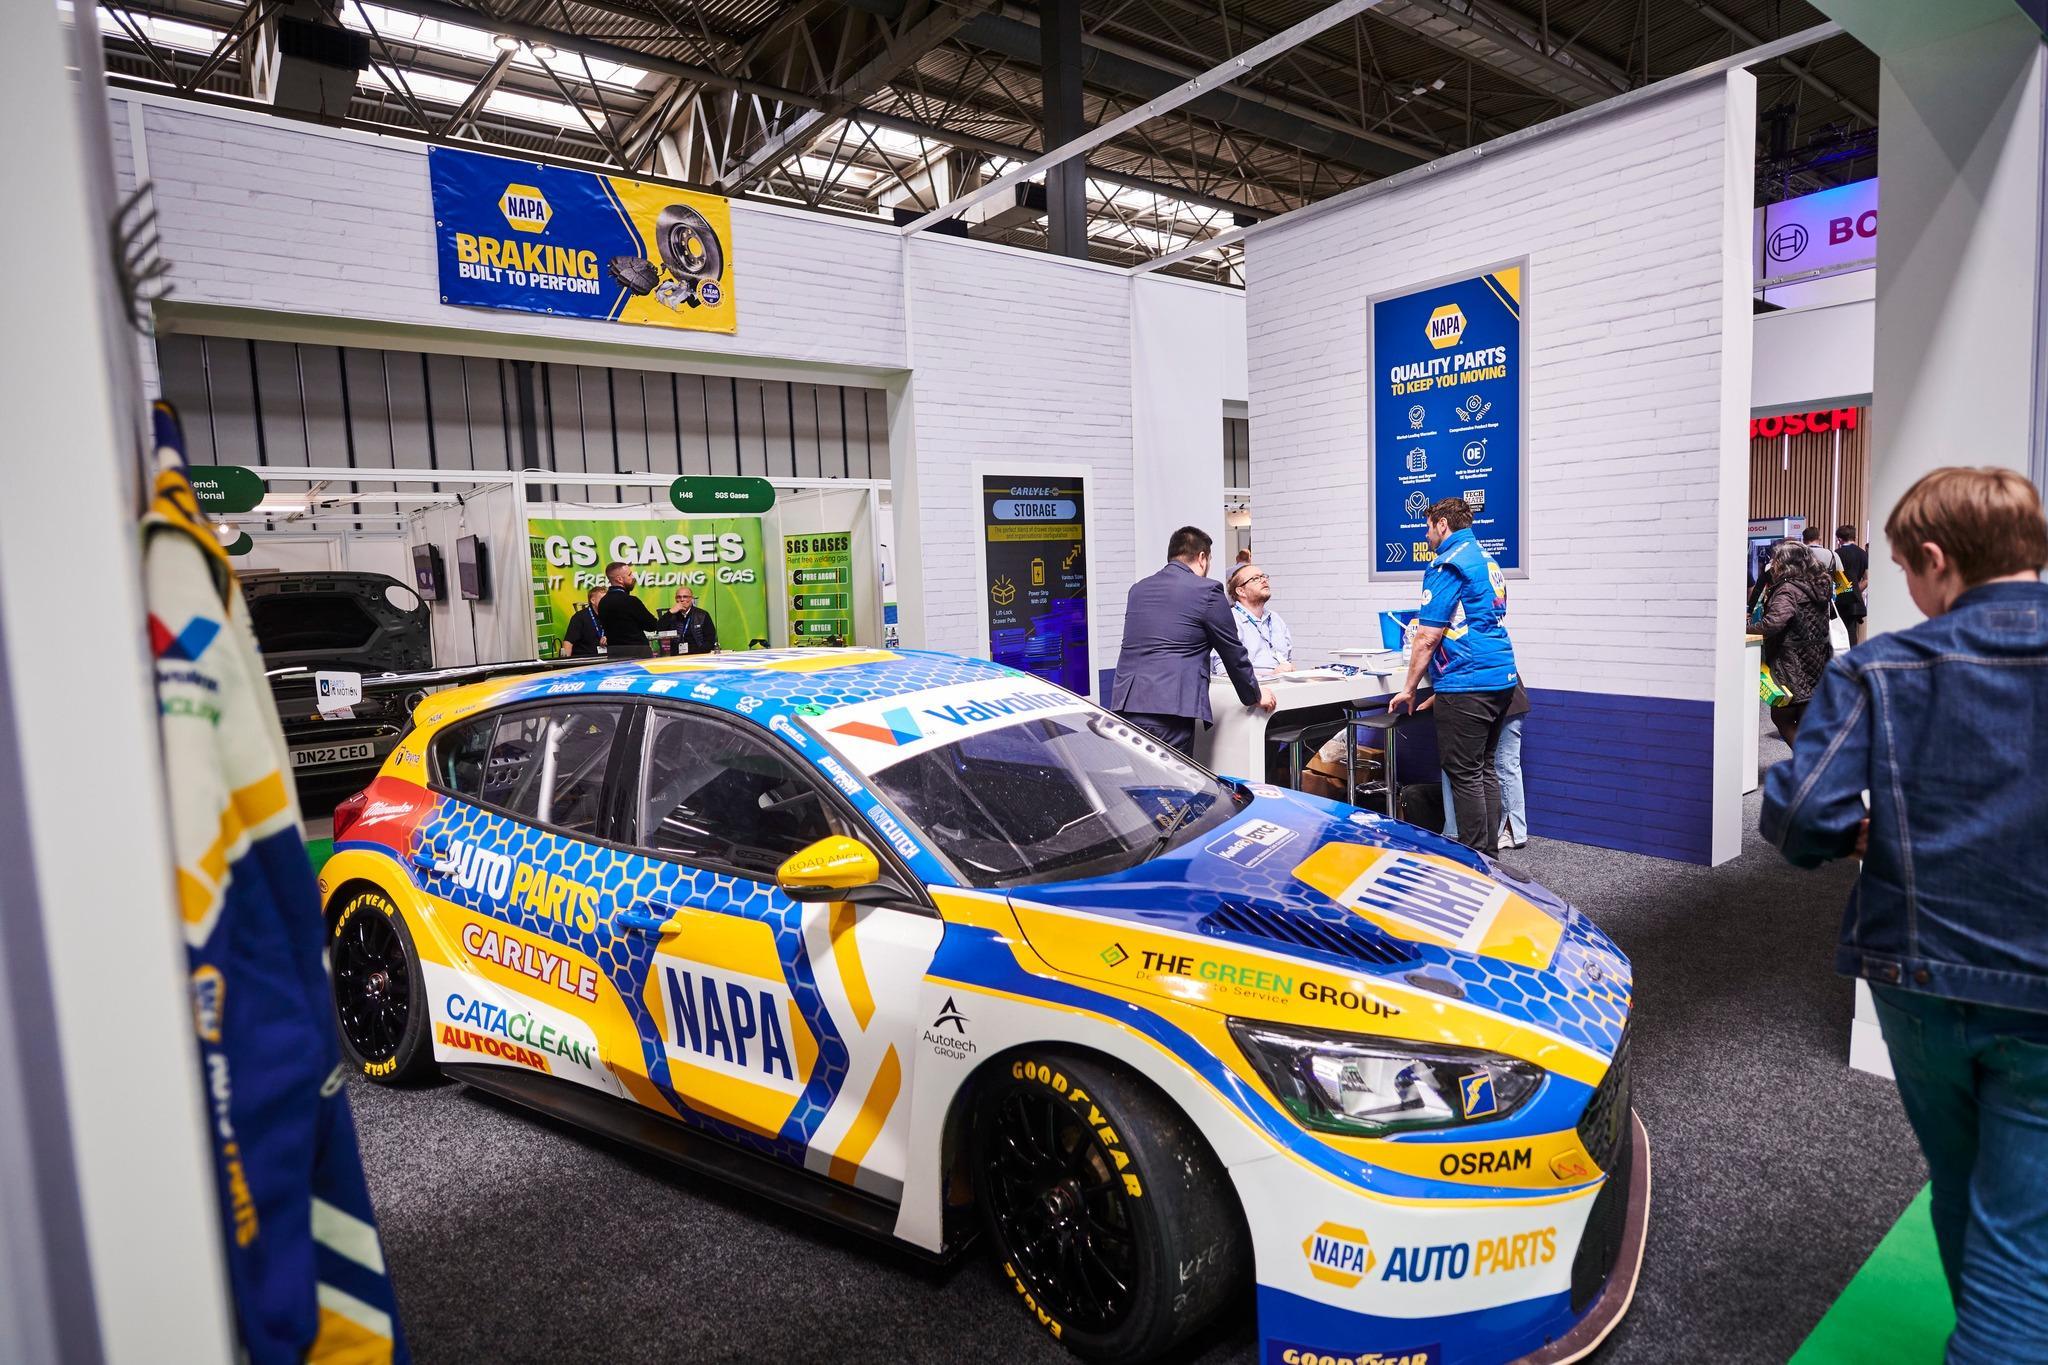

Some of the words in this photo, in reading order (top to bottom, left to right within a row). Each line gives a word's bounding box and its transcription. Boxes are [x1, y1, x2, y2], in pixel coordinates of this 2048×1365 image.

[507, 196, 545, 221] NAPA
[1829, 210, 1878, 246] BO
[456, 233, 599, 279] BRAKING
[459, 262, 501, 283] BUILT
[505, 269, 527, 286] TO
[530, 274, 600, 295] PERFORM
[1432, 315, 1460, 338] NAPA
[1391, 357, 1450, 383] QUALITY
[1455, 346, 1507, 371] PARTS
[1391, 384, 1405, 396] TO
[1407, 378, 1434, 394] KEEP
[1435, 373, 1458, 389] YOU
[1460, 365, 1506, 384] MOVING
[1466, 448, 1481, 460] OE
[190, 480, 218, 489] ench
[197, 491, 225, 500] tional
[679, 491, 693, 499] H48
[714, 491, 728, 499] SGS
[1010, 487, 1051, 496] CARLYLE
[1465, 490, 1484, 498] TECH
[1014, 503, 1057, 517] STORAGE
[544, 535, 597, 567] GS
[609, 533, 745, 564] GASES
[787, 540, 808, 553] SGS
[812, 537, 848, 553] GASES
[1413, 542, 1429, 551] DID
[716, 566, 755, 584] GAS
[337, 687, 358, 696] MOTION
[547, 681, 586, 694] DENSO
[922, 691, 1076, 726] Valvoline
[297, 749, 336, 764] DN22
[867, 804, 920, 860] UNICLUTCH
[789, 856, 824, 874] ROAD
[445, 840, 511, 900] AUTO
[509, 864, 598, 935] PARTS
[462, 922, 598, 1004] CARLYLE
[1141, 951, 1194, 976] THE
[1200, 961, 1293, 995] GREEN
[1300, 982, 1400, 1018] GROUP
[1234, 986, 1289, 1005] Service
[446, 994, 592, 1070] CATACLEAN
[666, 966, 794, 1081] NAPA
[442, 1025, 546, 1071] AUTOCAR
[922, 1030, 976, 1054] Autotech
[934, 1046, 966, 1060] GROUP
[364, 1056, 397, 1076] EAGLE
[1440, 1148, 1532, 1176] OSRAM
[1313, 1236, 1364, 1273] NAPA
[1381, 1243, 1469, 1283] AUTO
[1474, 1226, 1558, 1276] PARTS
[1003, 1262, 1062, 1341] EAGLE
